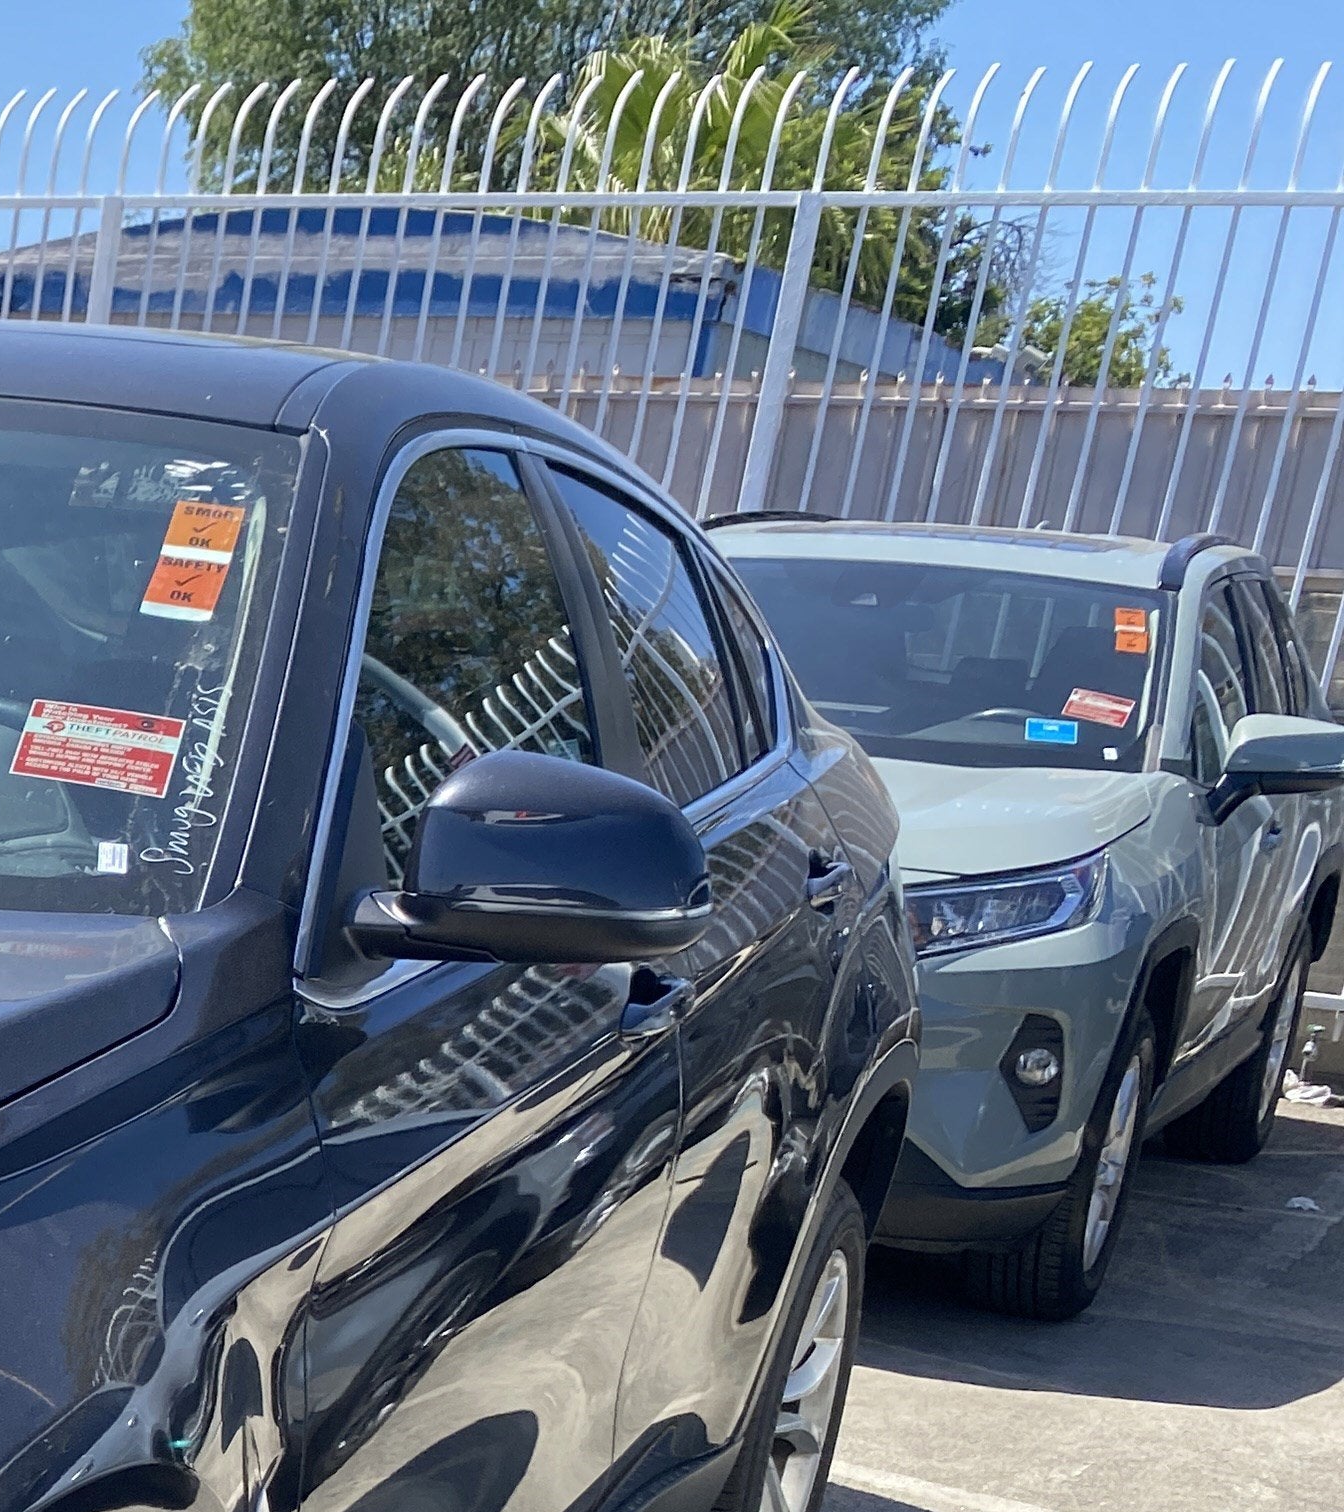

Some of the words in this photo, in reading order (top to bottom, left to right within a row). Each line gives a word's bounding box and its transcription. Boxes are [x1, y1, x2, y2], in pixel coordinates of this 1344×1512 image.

[188, 536, 212, 548] OK
[161, 557, 226, 573] SAFETY
[169, 590, 195, 603] OK
